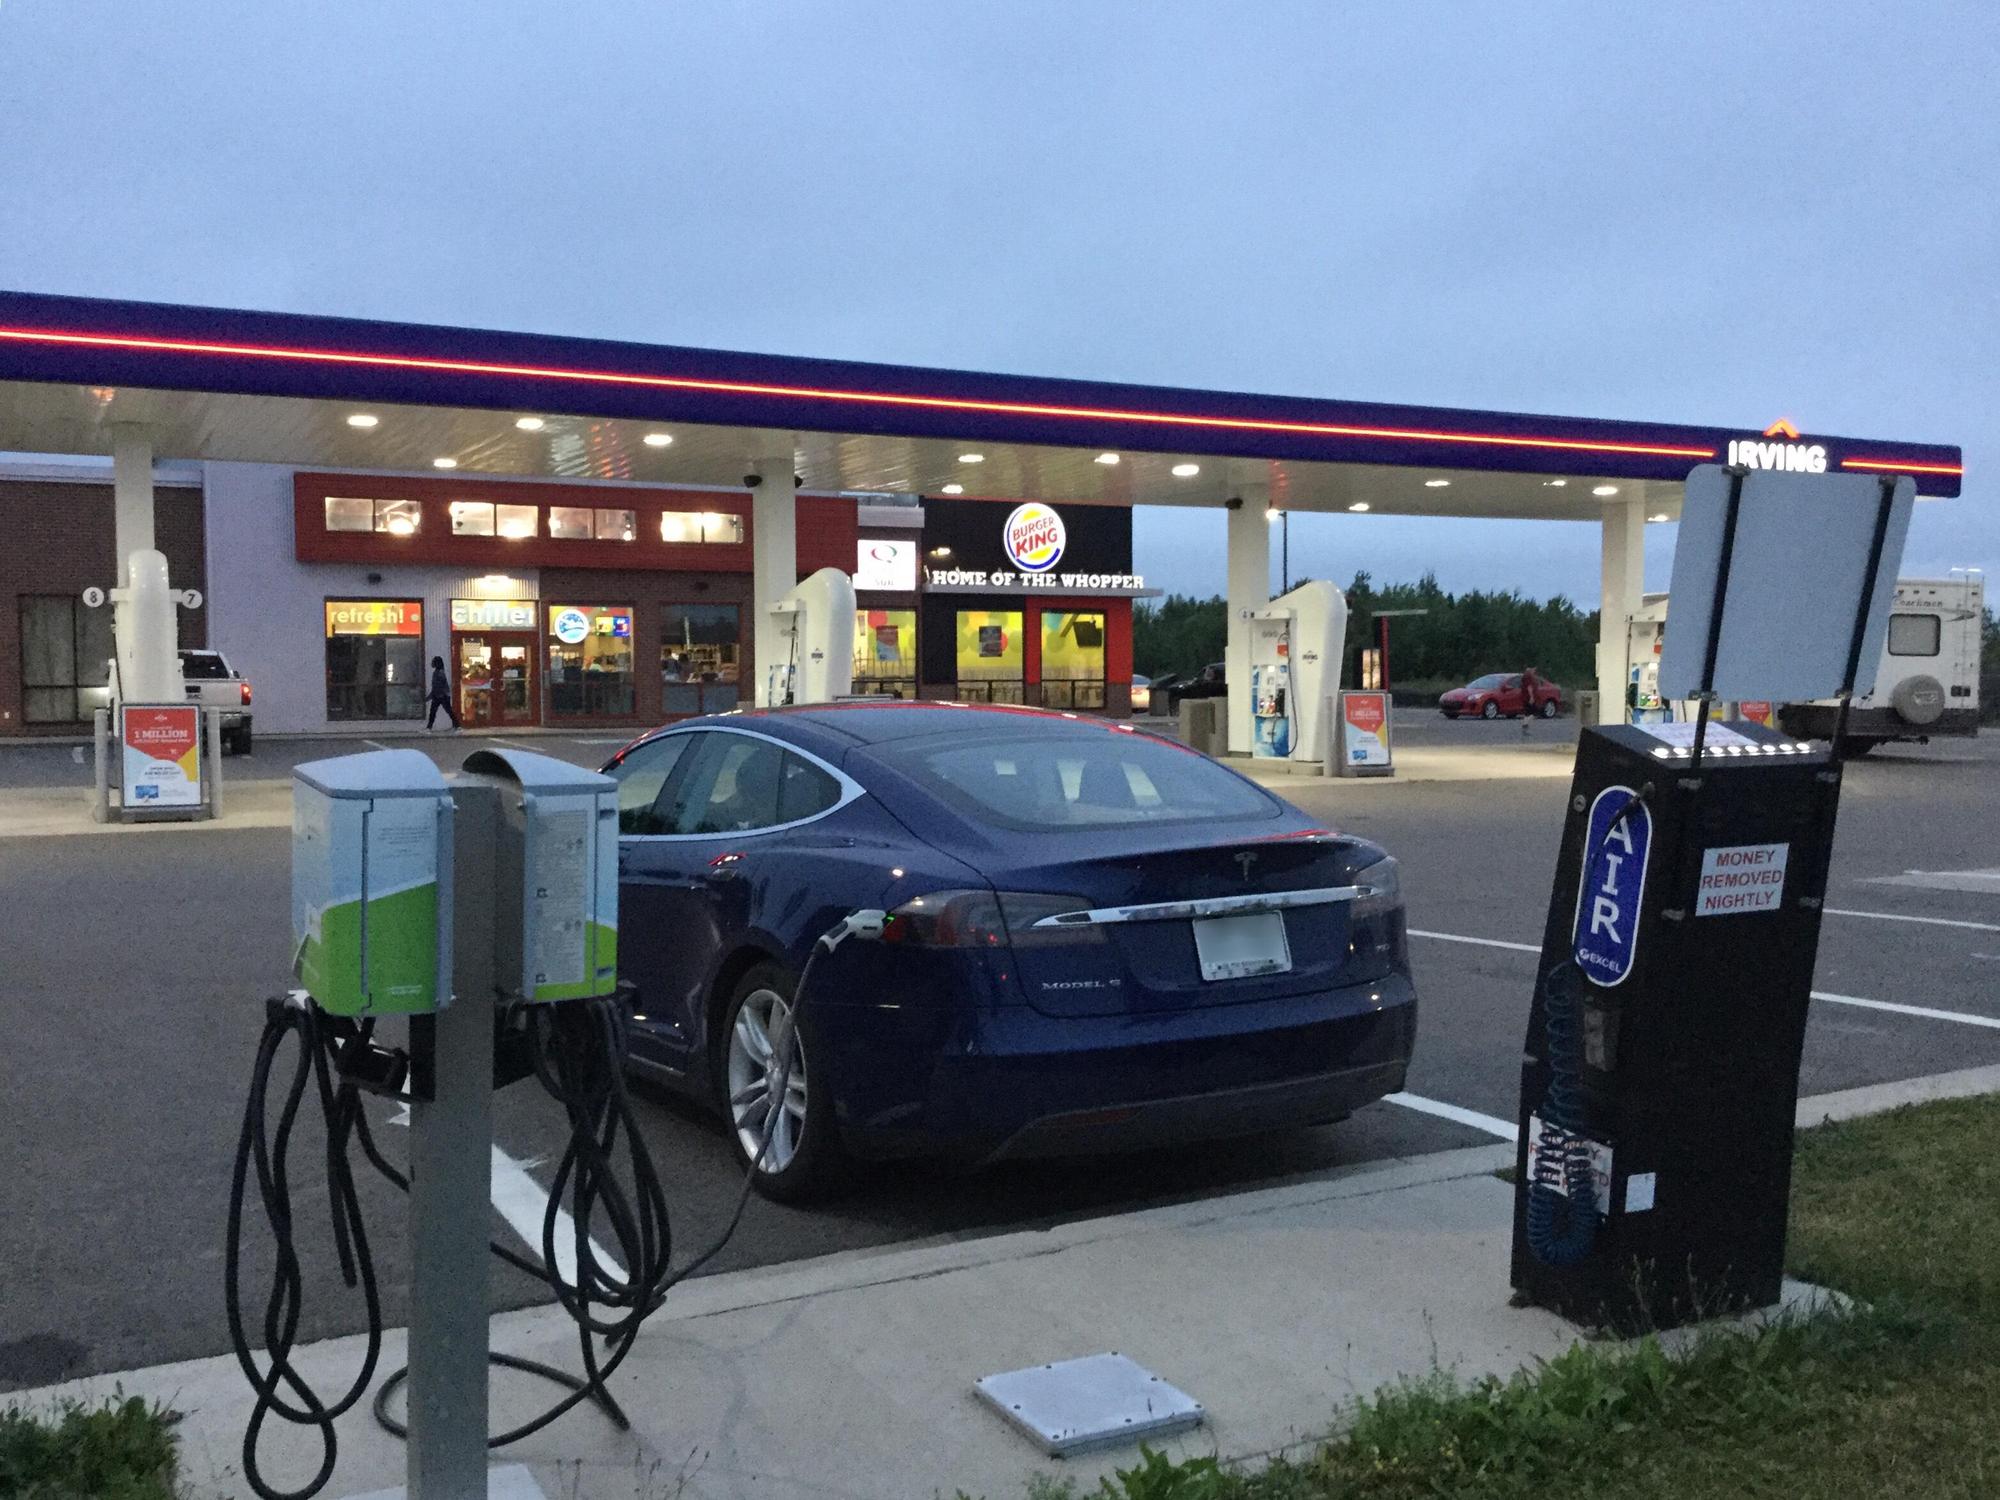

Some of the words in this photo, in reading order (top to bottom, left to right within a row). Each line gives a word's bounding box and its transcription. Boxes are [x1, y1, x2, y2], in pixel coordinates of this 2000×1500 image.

[1728, 440, 1827, 473] IRVING
[1013, 516, 1055, 541] BURGER
[1016, 527, 1058, 558] KING
[932, 570, 987, 586] HOME
[991, 572, 1016, 587] OF
[1020, 573, 1056, 587] THE
[1061, 574, 1145, 589] WHOPPER
[89, 590, 98, 604] 8
[187, 593, 196, 605] 7
[331, 607, 404, 624] refresh!
[142, 730, 188, 738] MILLION
[1716, 850, 1775, 867] MONEY
[1590, 811, 1633, 944] AIR
[1701, 870, 1783, 890] REMOVED
[1705, 891, 1775, 910] NIGHTLY
[1590, 953, 1622, 974] EXCEL
[1041, 981, 1105, 990] MODEL
